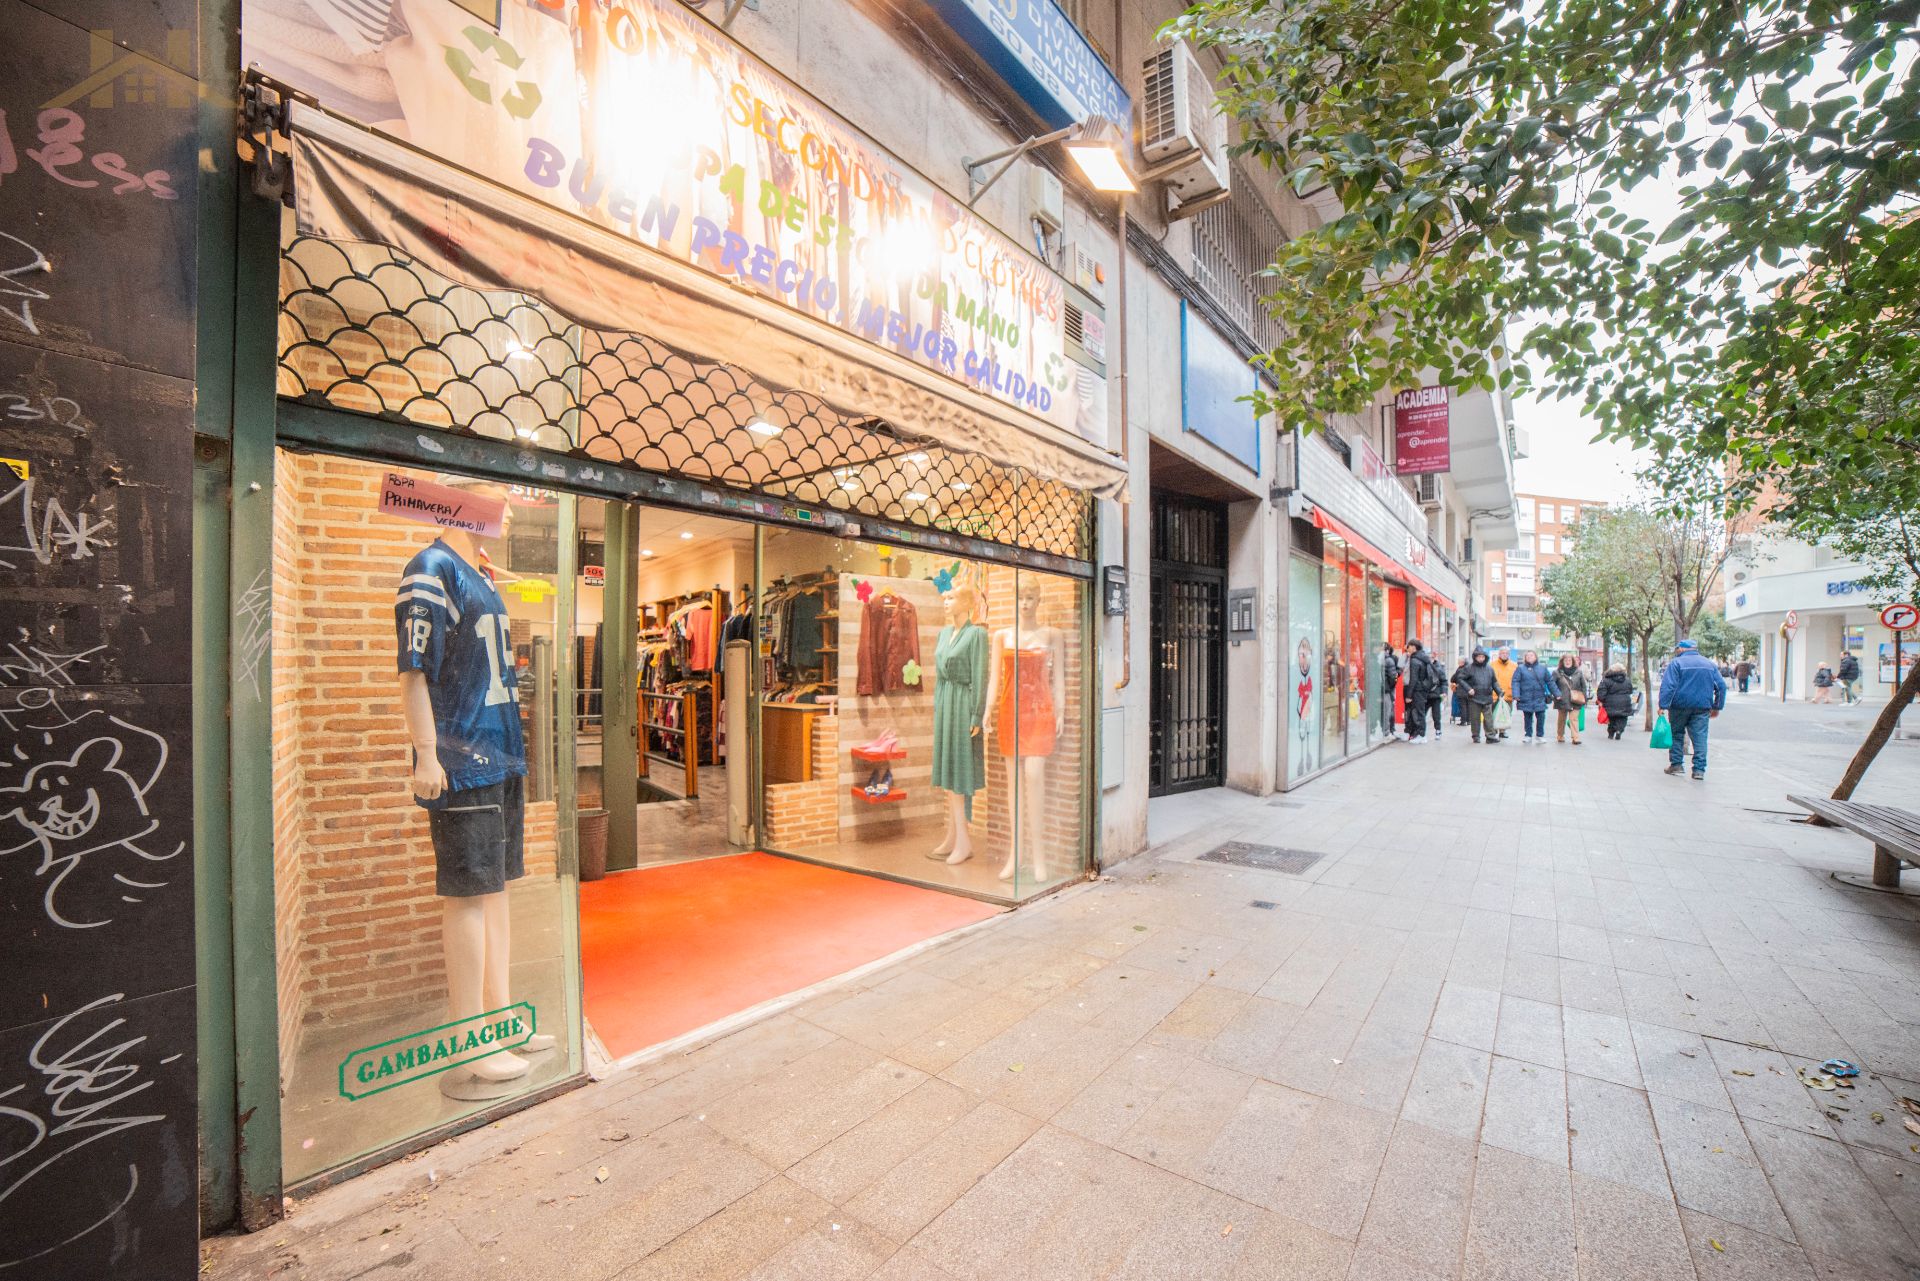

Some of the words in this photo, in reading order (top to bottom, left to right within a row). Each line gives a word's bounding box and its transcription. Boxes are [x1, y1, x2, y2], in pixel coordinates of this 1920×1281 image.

[759, 179, 807, 233] DE
[955, 292, 1020, 349] MANO
[965, 240, 1057, 322] CLOTHES
[857, 297, 958, 371] MEJOR
[964, 349, 1052, 413] CALIDAD
[1397, 386, 1448, 410] ACADEMIA
[405, 617, 432, 654] 18
[356, 1015, 524, 1083] CAMBALACHE
